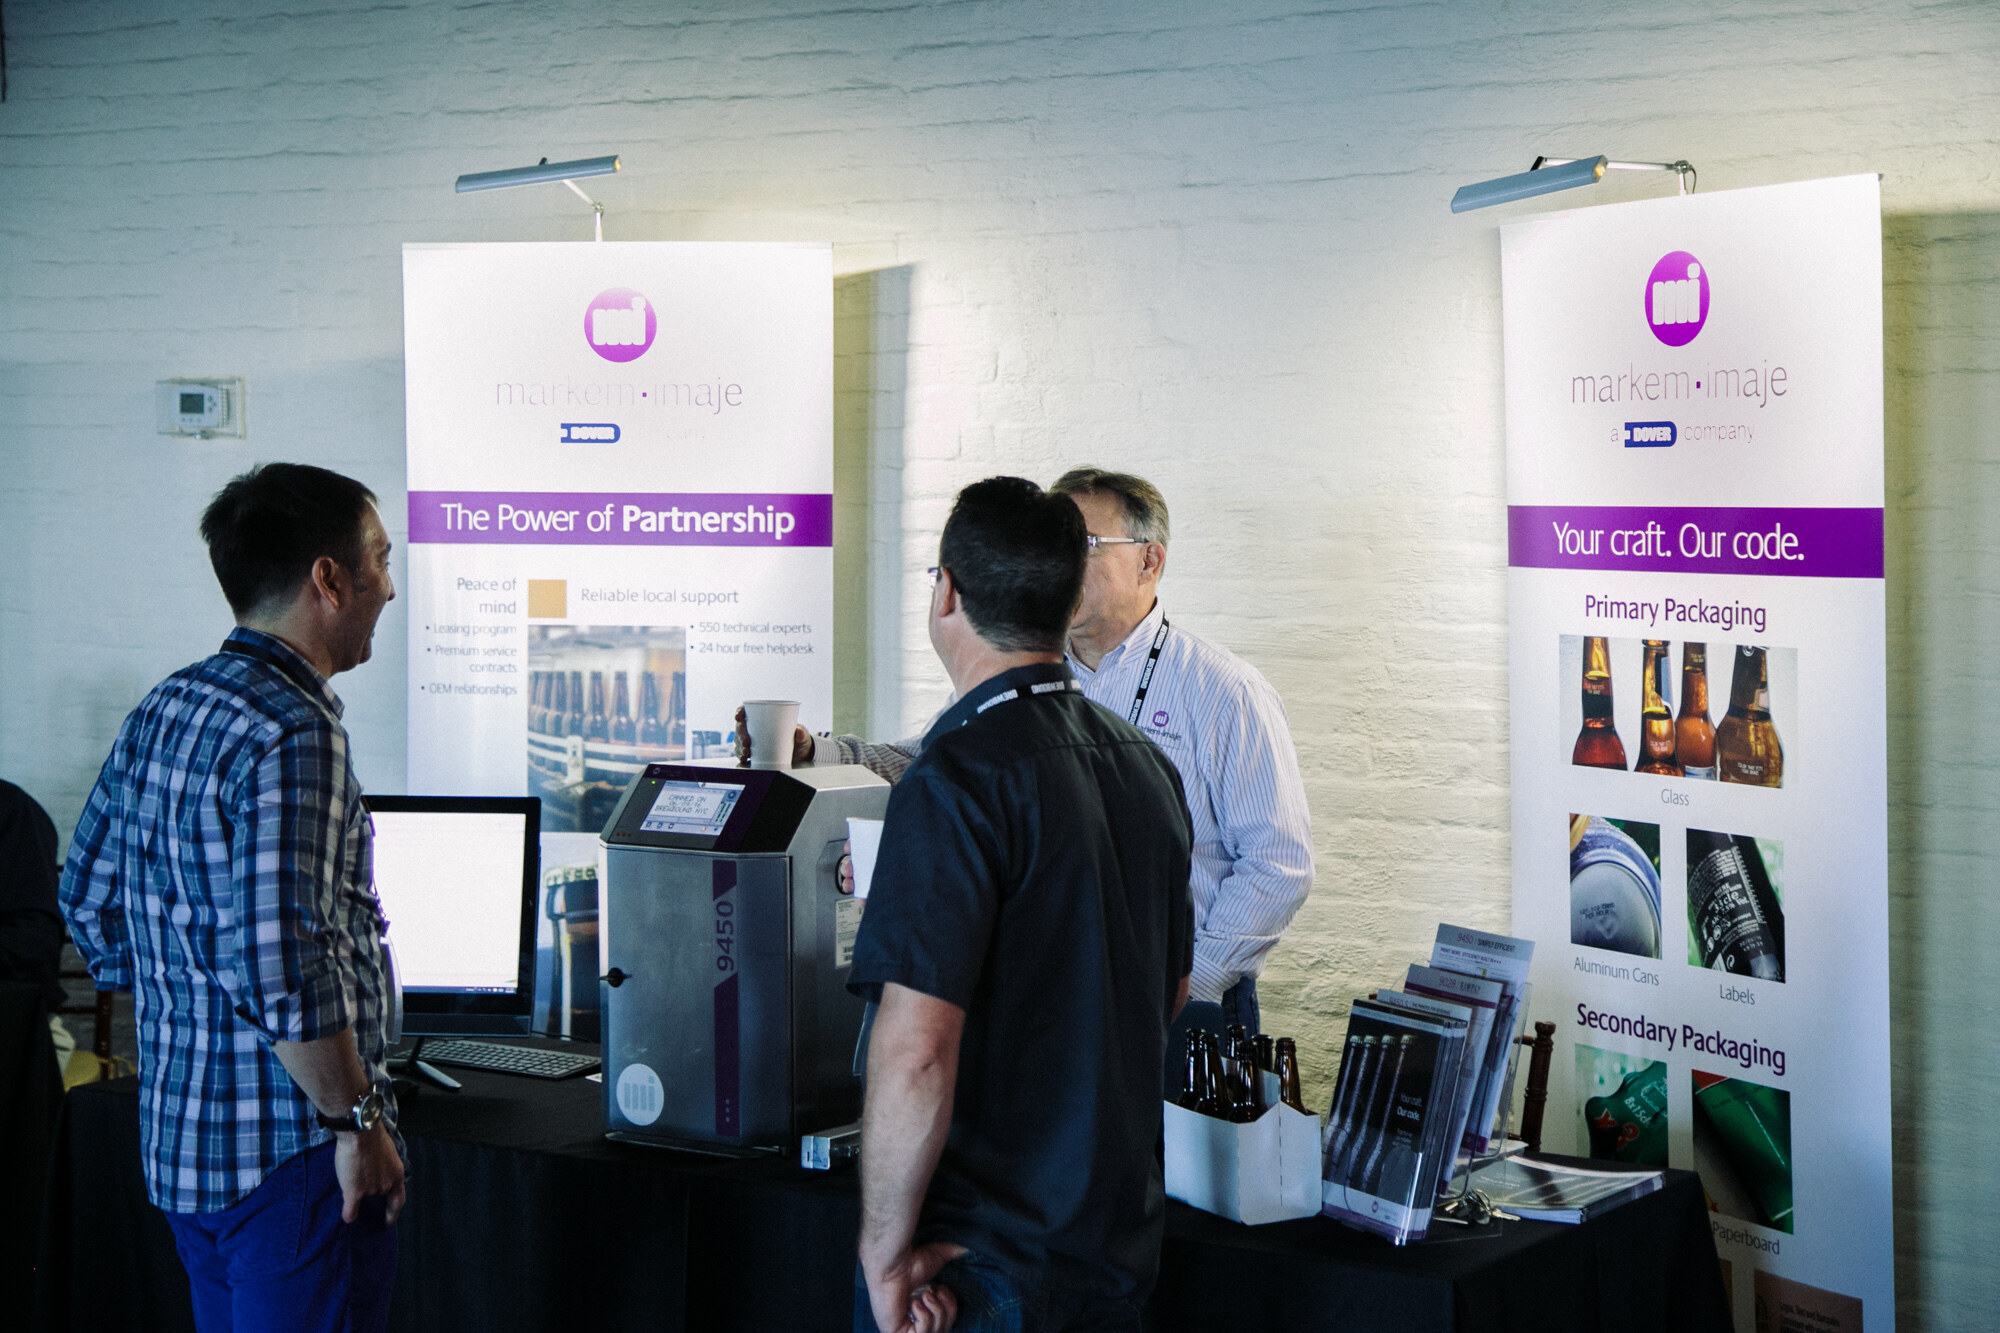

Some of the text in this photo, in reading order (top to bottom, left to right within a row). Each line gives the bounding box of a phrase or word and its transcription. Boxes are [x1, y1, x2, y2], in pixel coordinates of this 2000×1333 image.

[1610, 424, 1755, 444] a DOVER company
[441, 503, 795, 540] The Power of Partnership
[1552, 521, 1805, 560] Your craft. Our code.
[457, 577, 517, 591] Peace of
[581, 588, 739, 605] Reliable local support
[479, 600, 517, 614] mind
[1585, 594, 1767, 633] Primary Packaging
[433, 623, 517, 637] Leasing program
[699, 622, 812, 636] 550 technical experts
[435, 645, 518, 657] Premium service
[699, 642, 814, 656] 24 hour free helpdesk
[469, 663, 517, 673] contracts
[429, 682, 518, 696] OEM relationships
[1660, 788, 1690, 807] Glass
[715, 901, 734, 971] 9450
[1574, 956, 1659, 986] Aluminum Cans
[1719, 984, 1756, 1006] Labels
[1577, 1003, 1786, 1077] Secondary Packaging
[1712, 1220, 1780, 1255] Paperboard
